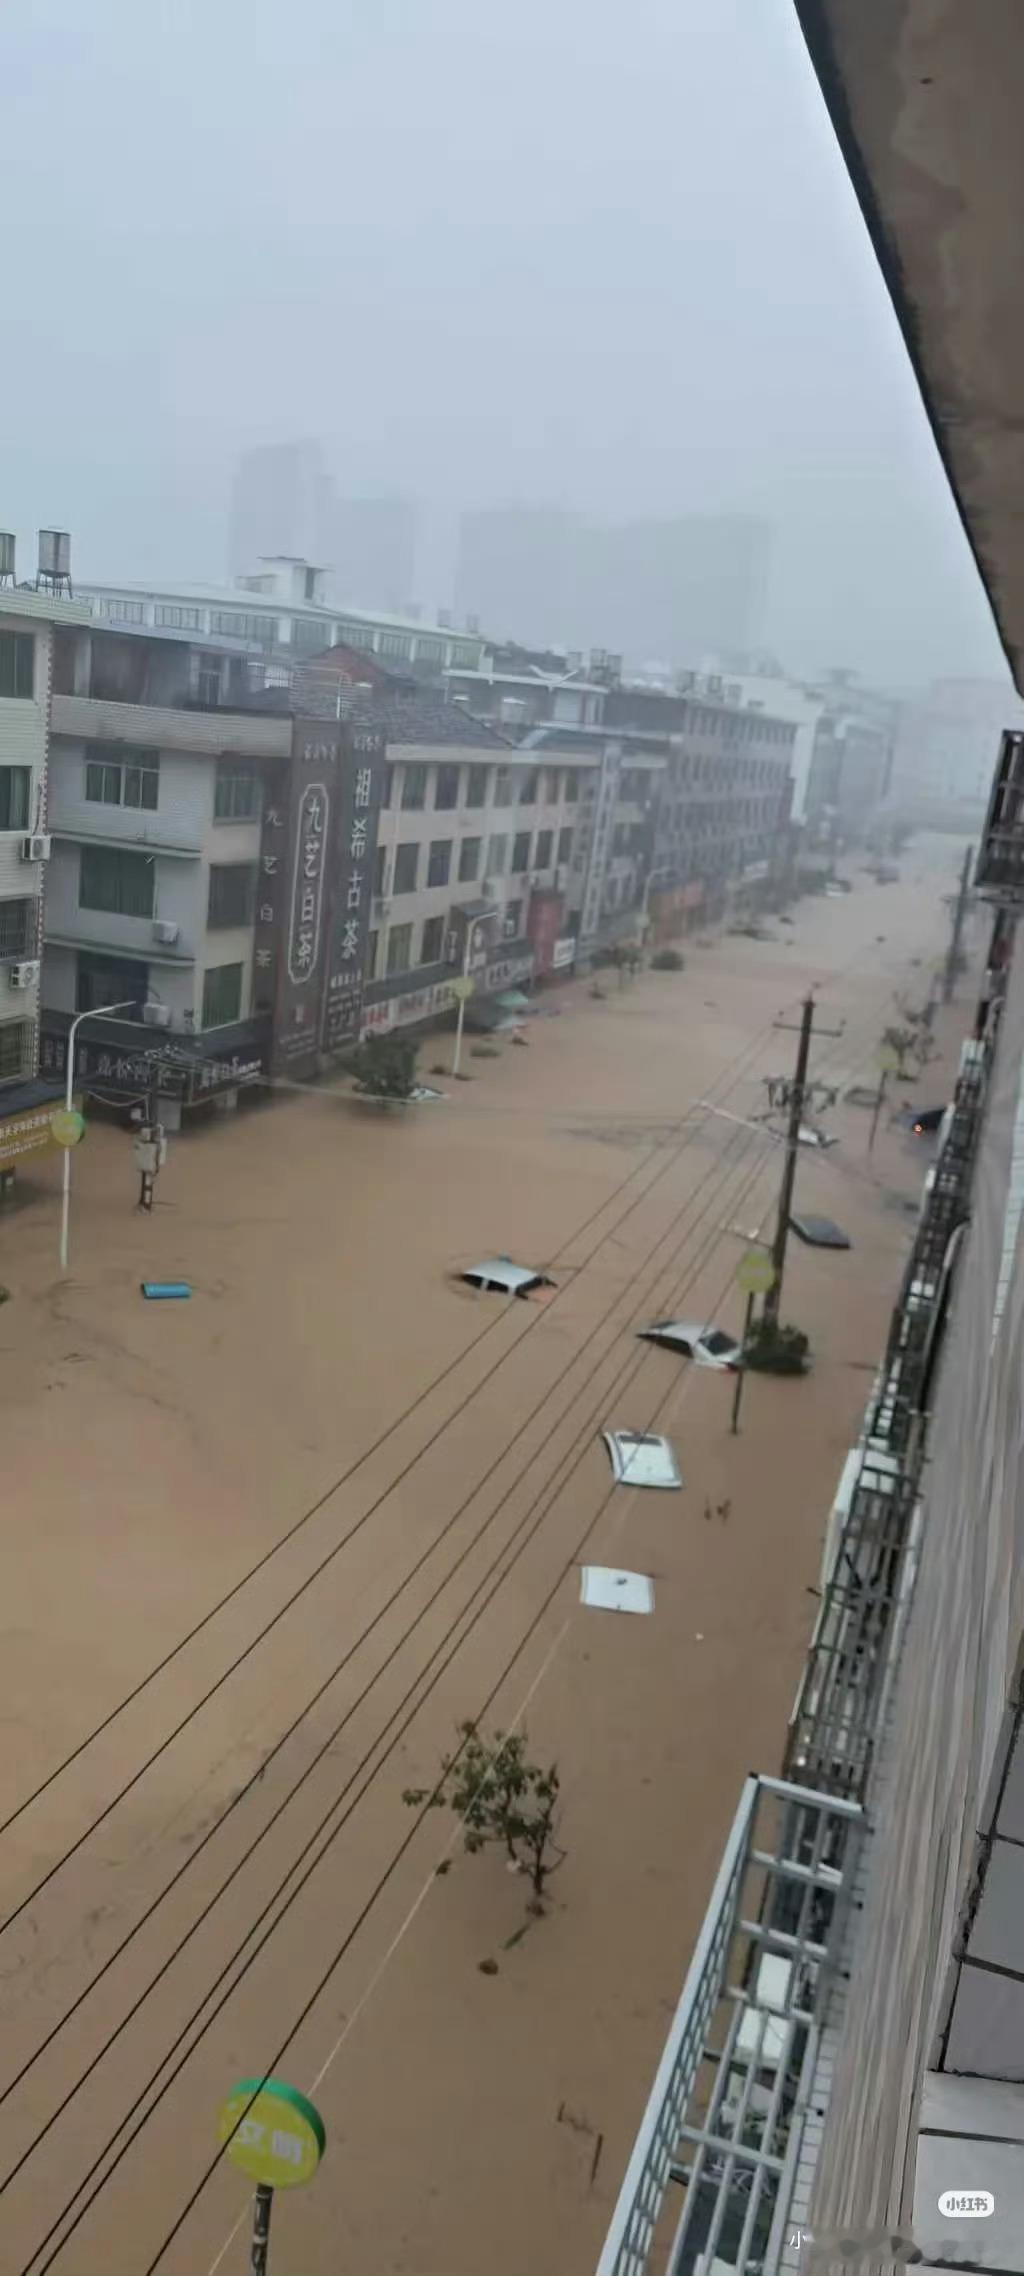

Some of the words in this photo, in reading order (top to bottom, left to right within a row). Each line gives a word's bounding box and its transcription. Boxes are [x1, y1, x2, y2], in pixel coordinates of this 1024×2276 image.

[255, 809, 283, 967] 九艺白茶
[298, 797, 323, 968] 九艺白茶
[341, 768, 371, 959] 祖希古茶
